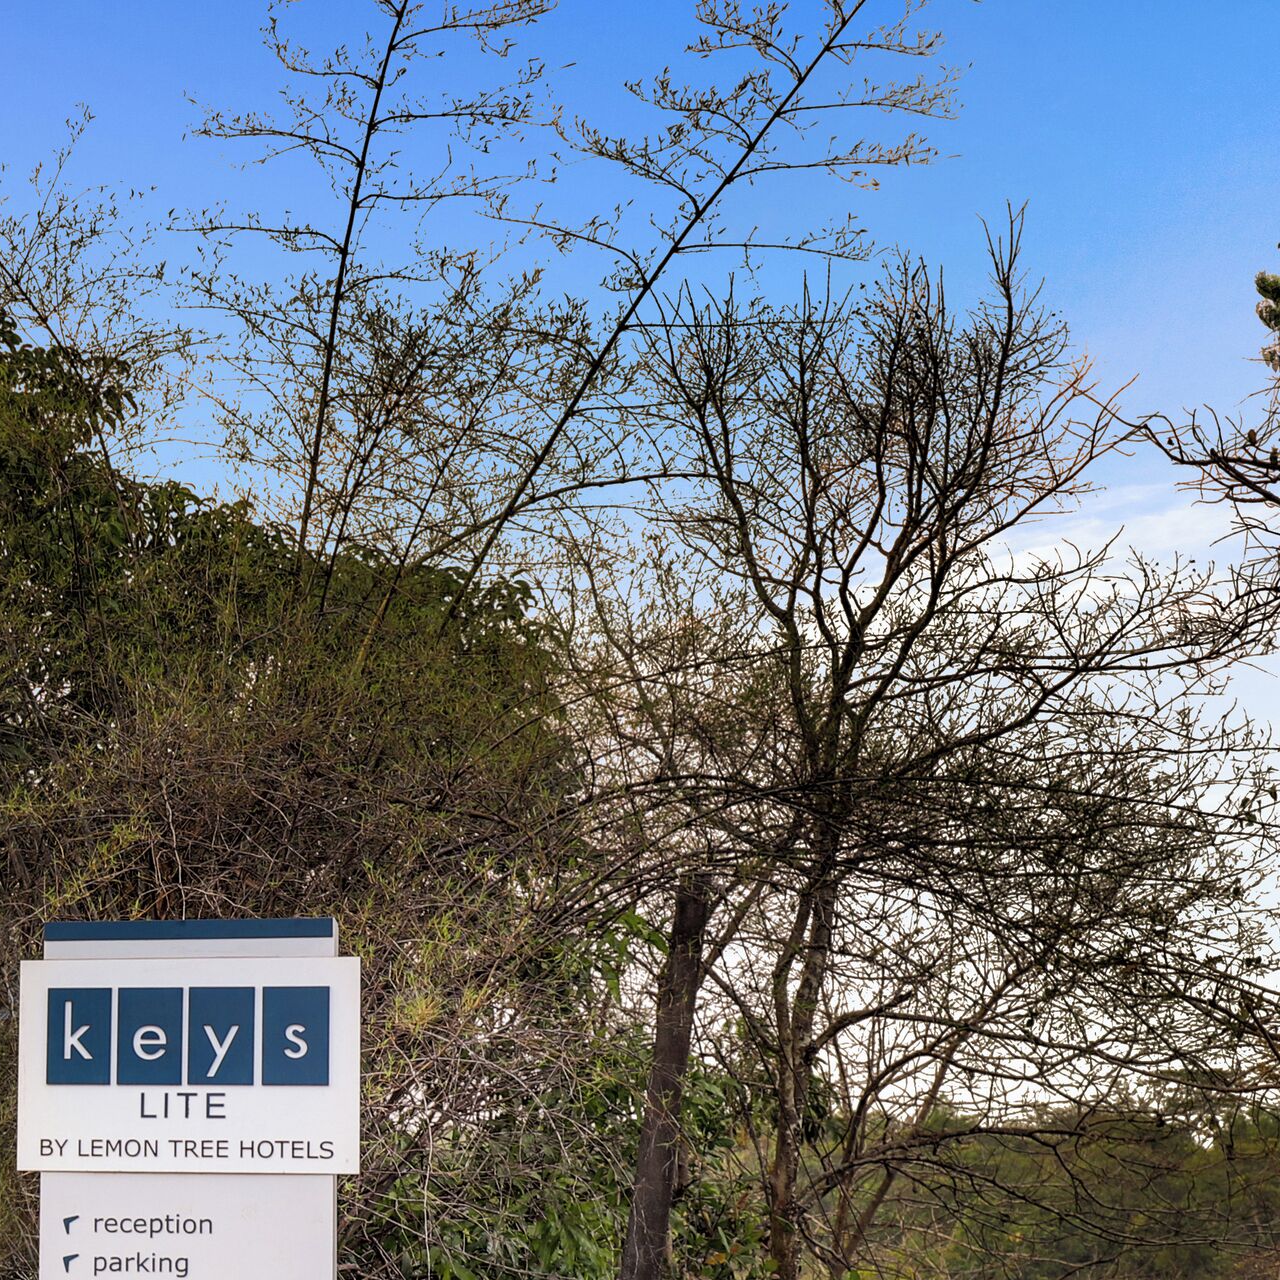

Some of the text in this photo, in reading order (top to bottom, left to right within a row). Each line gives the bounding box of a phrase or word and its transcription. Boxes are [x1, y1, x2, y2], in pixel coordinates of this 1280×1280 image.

[62, 1000, 309, 1078] keys
[140, 1092, 227, 1119] LITE
[40, 1139, 335, 1159] BY LEMON TREE HOTELS
[93, 1214, 213, 1238] reception
[93, 1253, 189, 1278] parking
